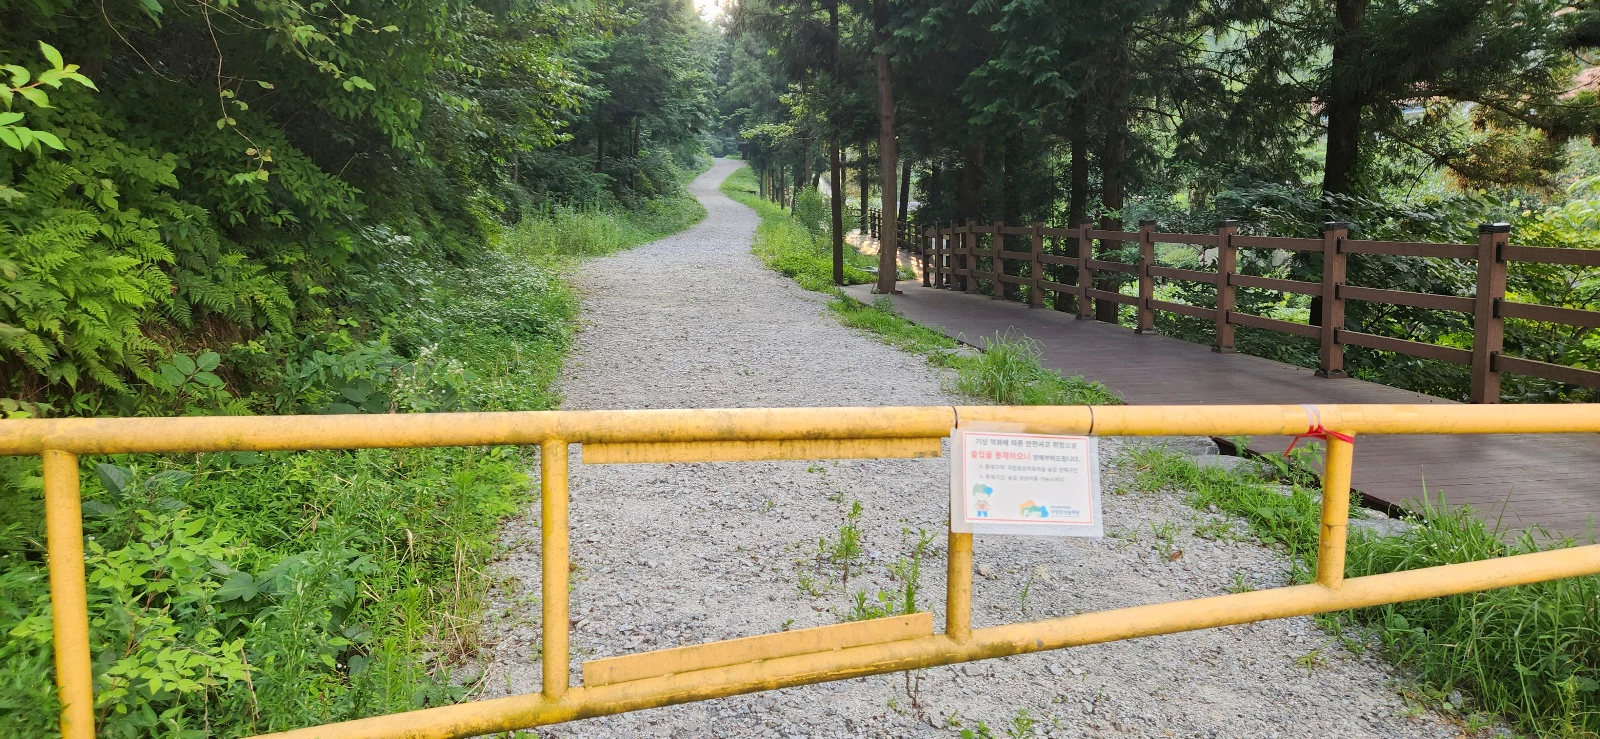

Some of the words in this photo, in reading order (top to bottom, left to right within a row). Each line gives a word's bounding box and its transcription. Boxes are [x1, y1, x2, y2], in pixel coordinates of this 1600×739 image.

[989, 438, 1009, 447] 악화에
[1010, 439, 1024, 448] 따른
[1025, 440, 1050, 449] 안전사고
[1052, 441, 1077, 450] 위험으로
[971, 451, 992, 459] 출입을
[995, 451, 1030, 461] 통제하오니
